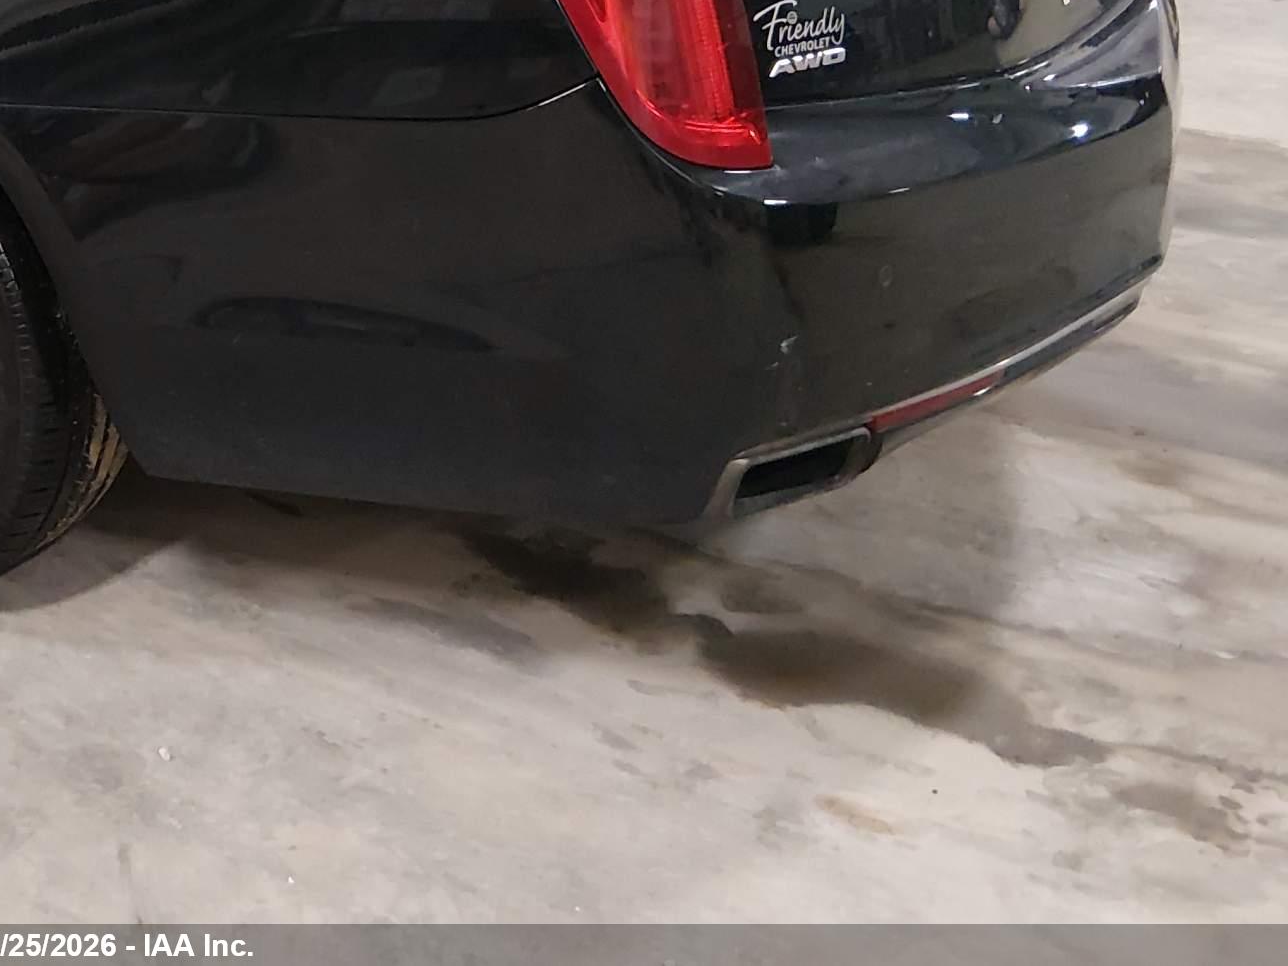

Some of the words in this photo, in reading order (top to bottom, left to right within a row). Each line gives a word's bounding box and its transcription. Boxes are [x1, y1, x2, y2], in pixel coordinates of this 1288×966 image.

[753, 0, 845, 51] Friendly
[769, 47, 846, 78] AWD
[775, 36, 831, 58] CHEVROLET
